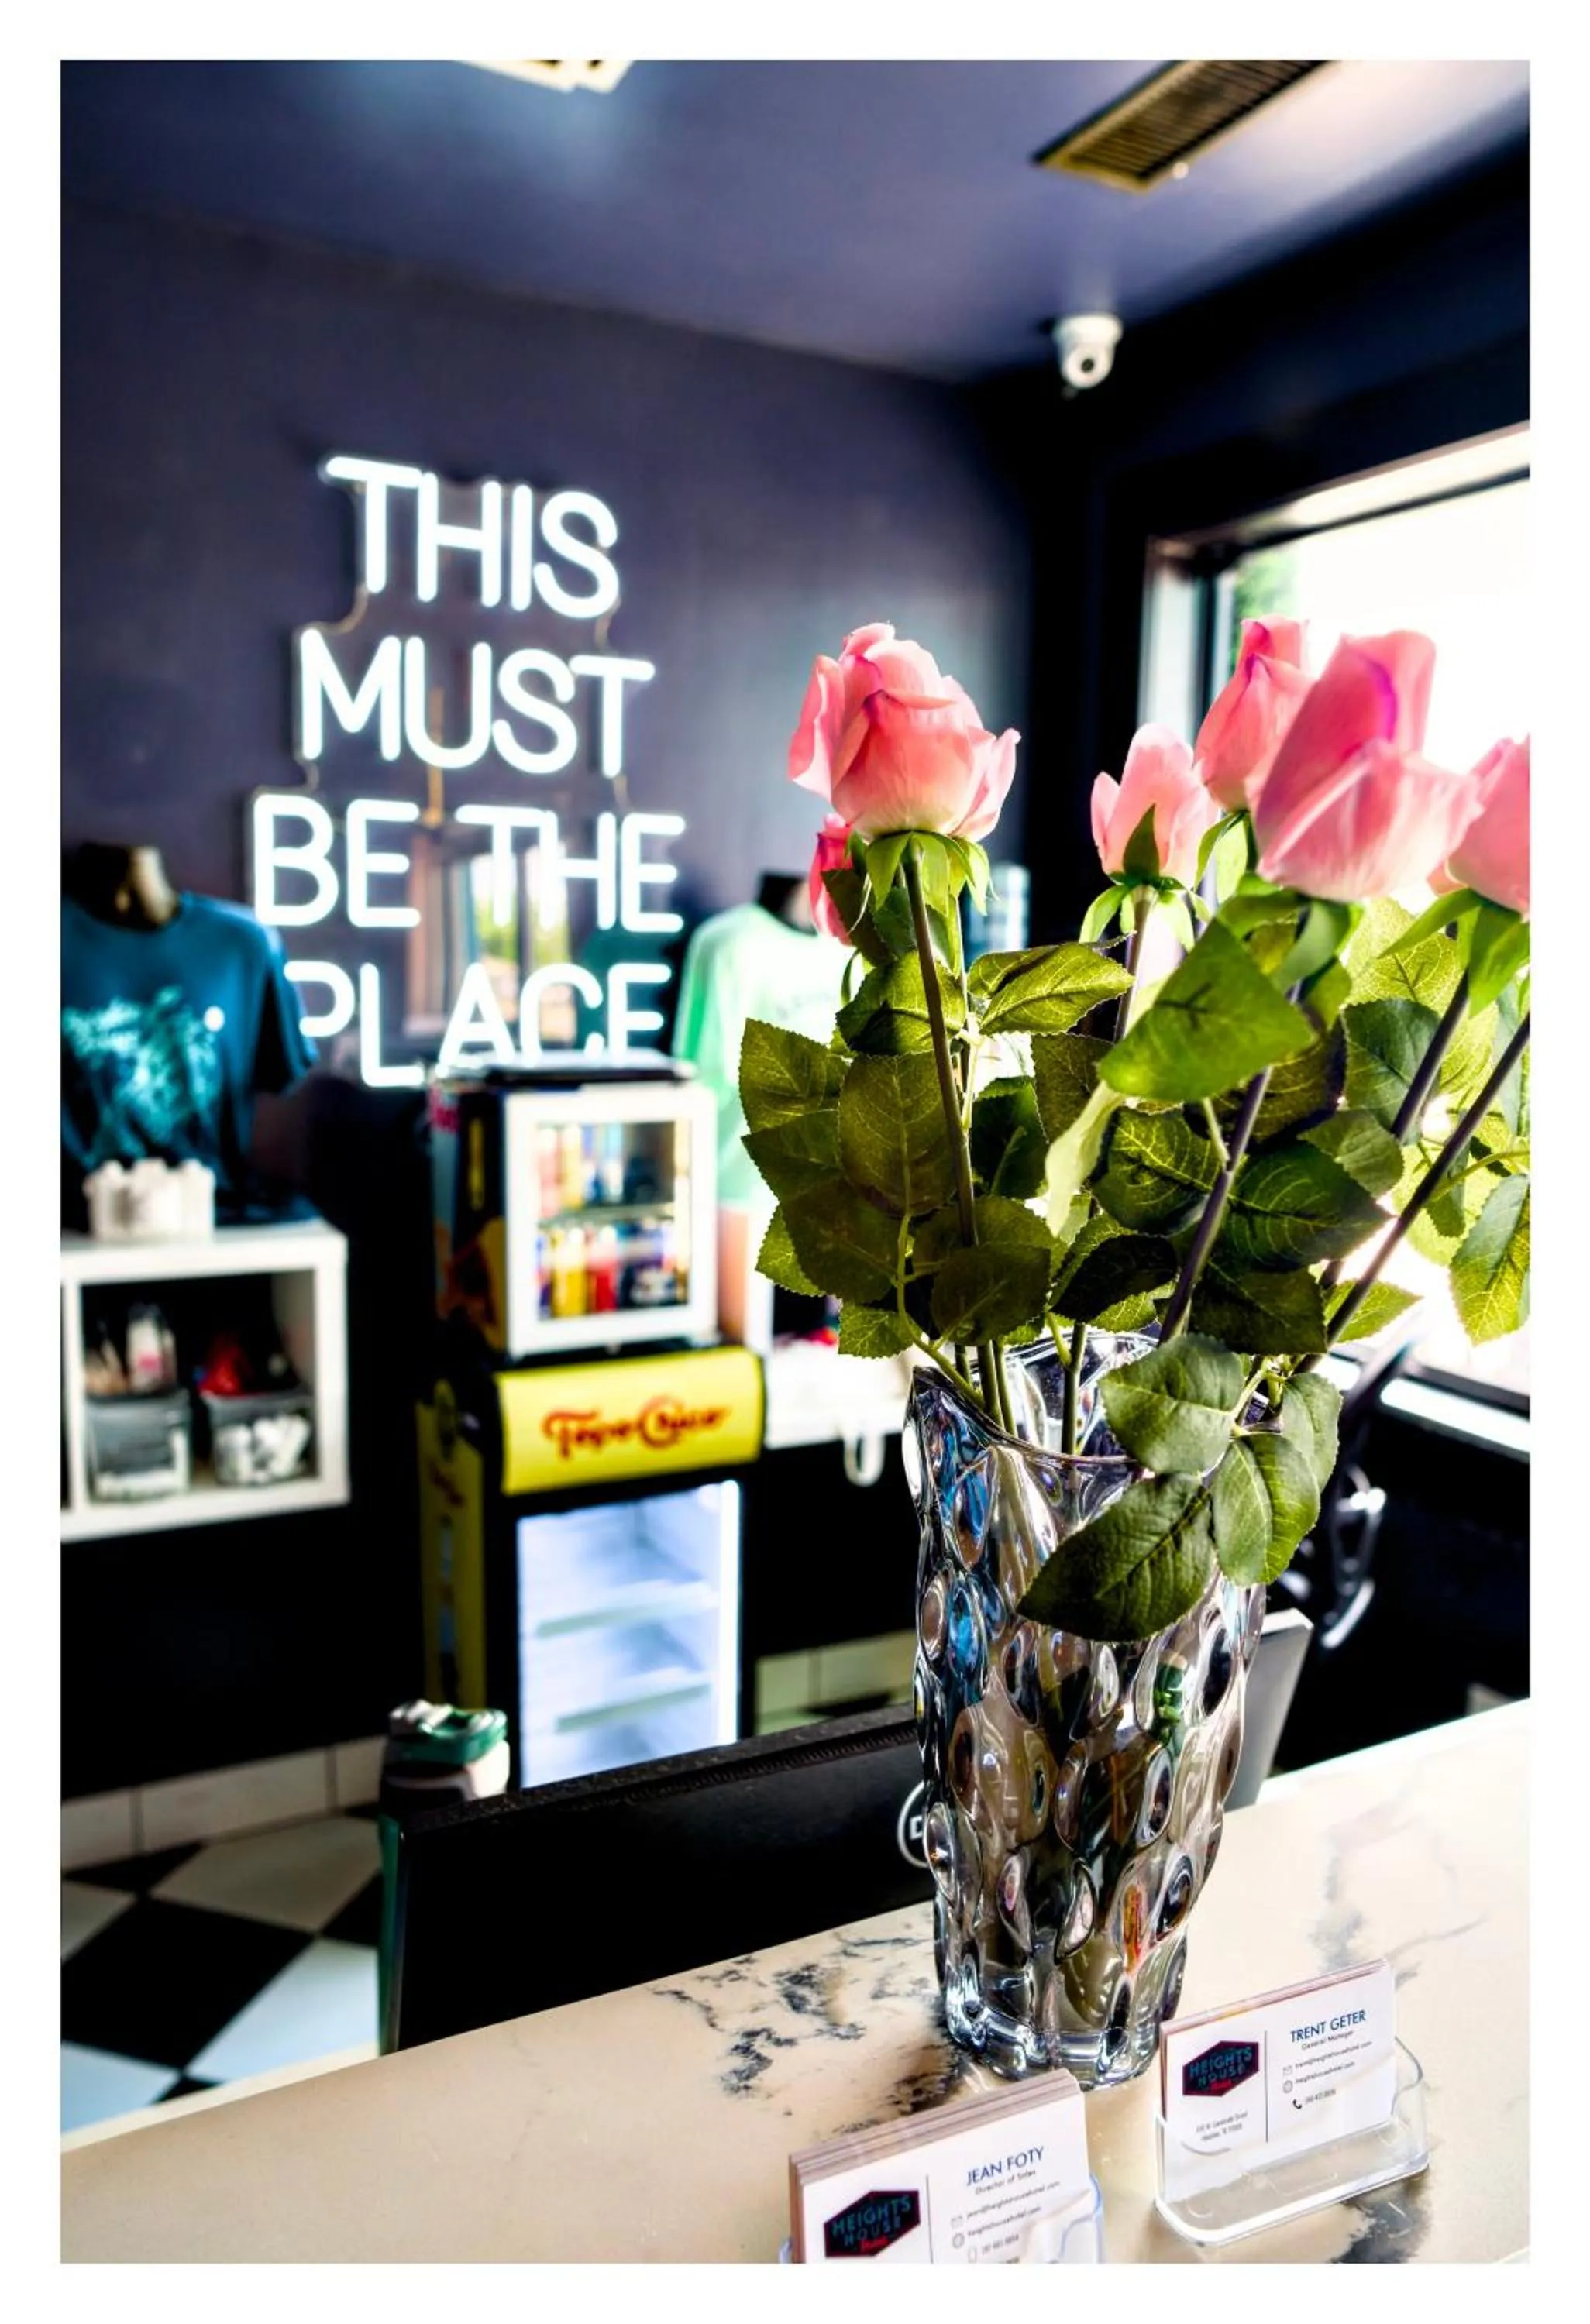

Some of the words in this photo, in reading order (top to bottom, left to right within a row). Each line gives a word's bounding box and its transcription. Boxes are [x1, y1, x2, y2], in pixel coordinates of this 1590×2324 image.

[325, 456, 620, 620] THIS
[300, 628, 655, 779] MUST
[253, 793, 421, 929] BE
[455, 804, 687, 933] THE
[284, 961, 673, 1089] PLACE
[1290, 2021, 1326, 2043] TRENT
[1330, 2009, 1366, 2030] GETER
[1189, 2046, 1253, 2078] HEIGHTS
[1198, 2062, 1246, 2089] HOUSE
[967, 2161, 1001, 2186] JEAN
[1007, 2146, 1045, 2170] FOTY
[832, 2195, 911, 2237] HEIGHTS
[844, 2216, 900, 2247] HOUSE
